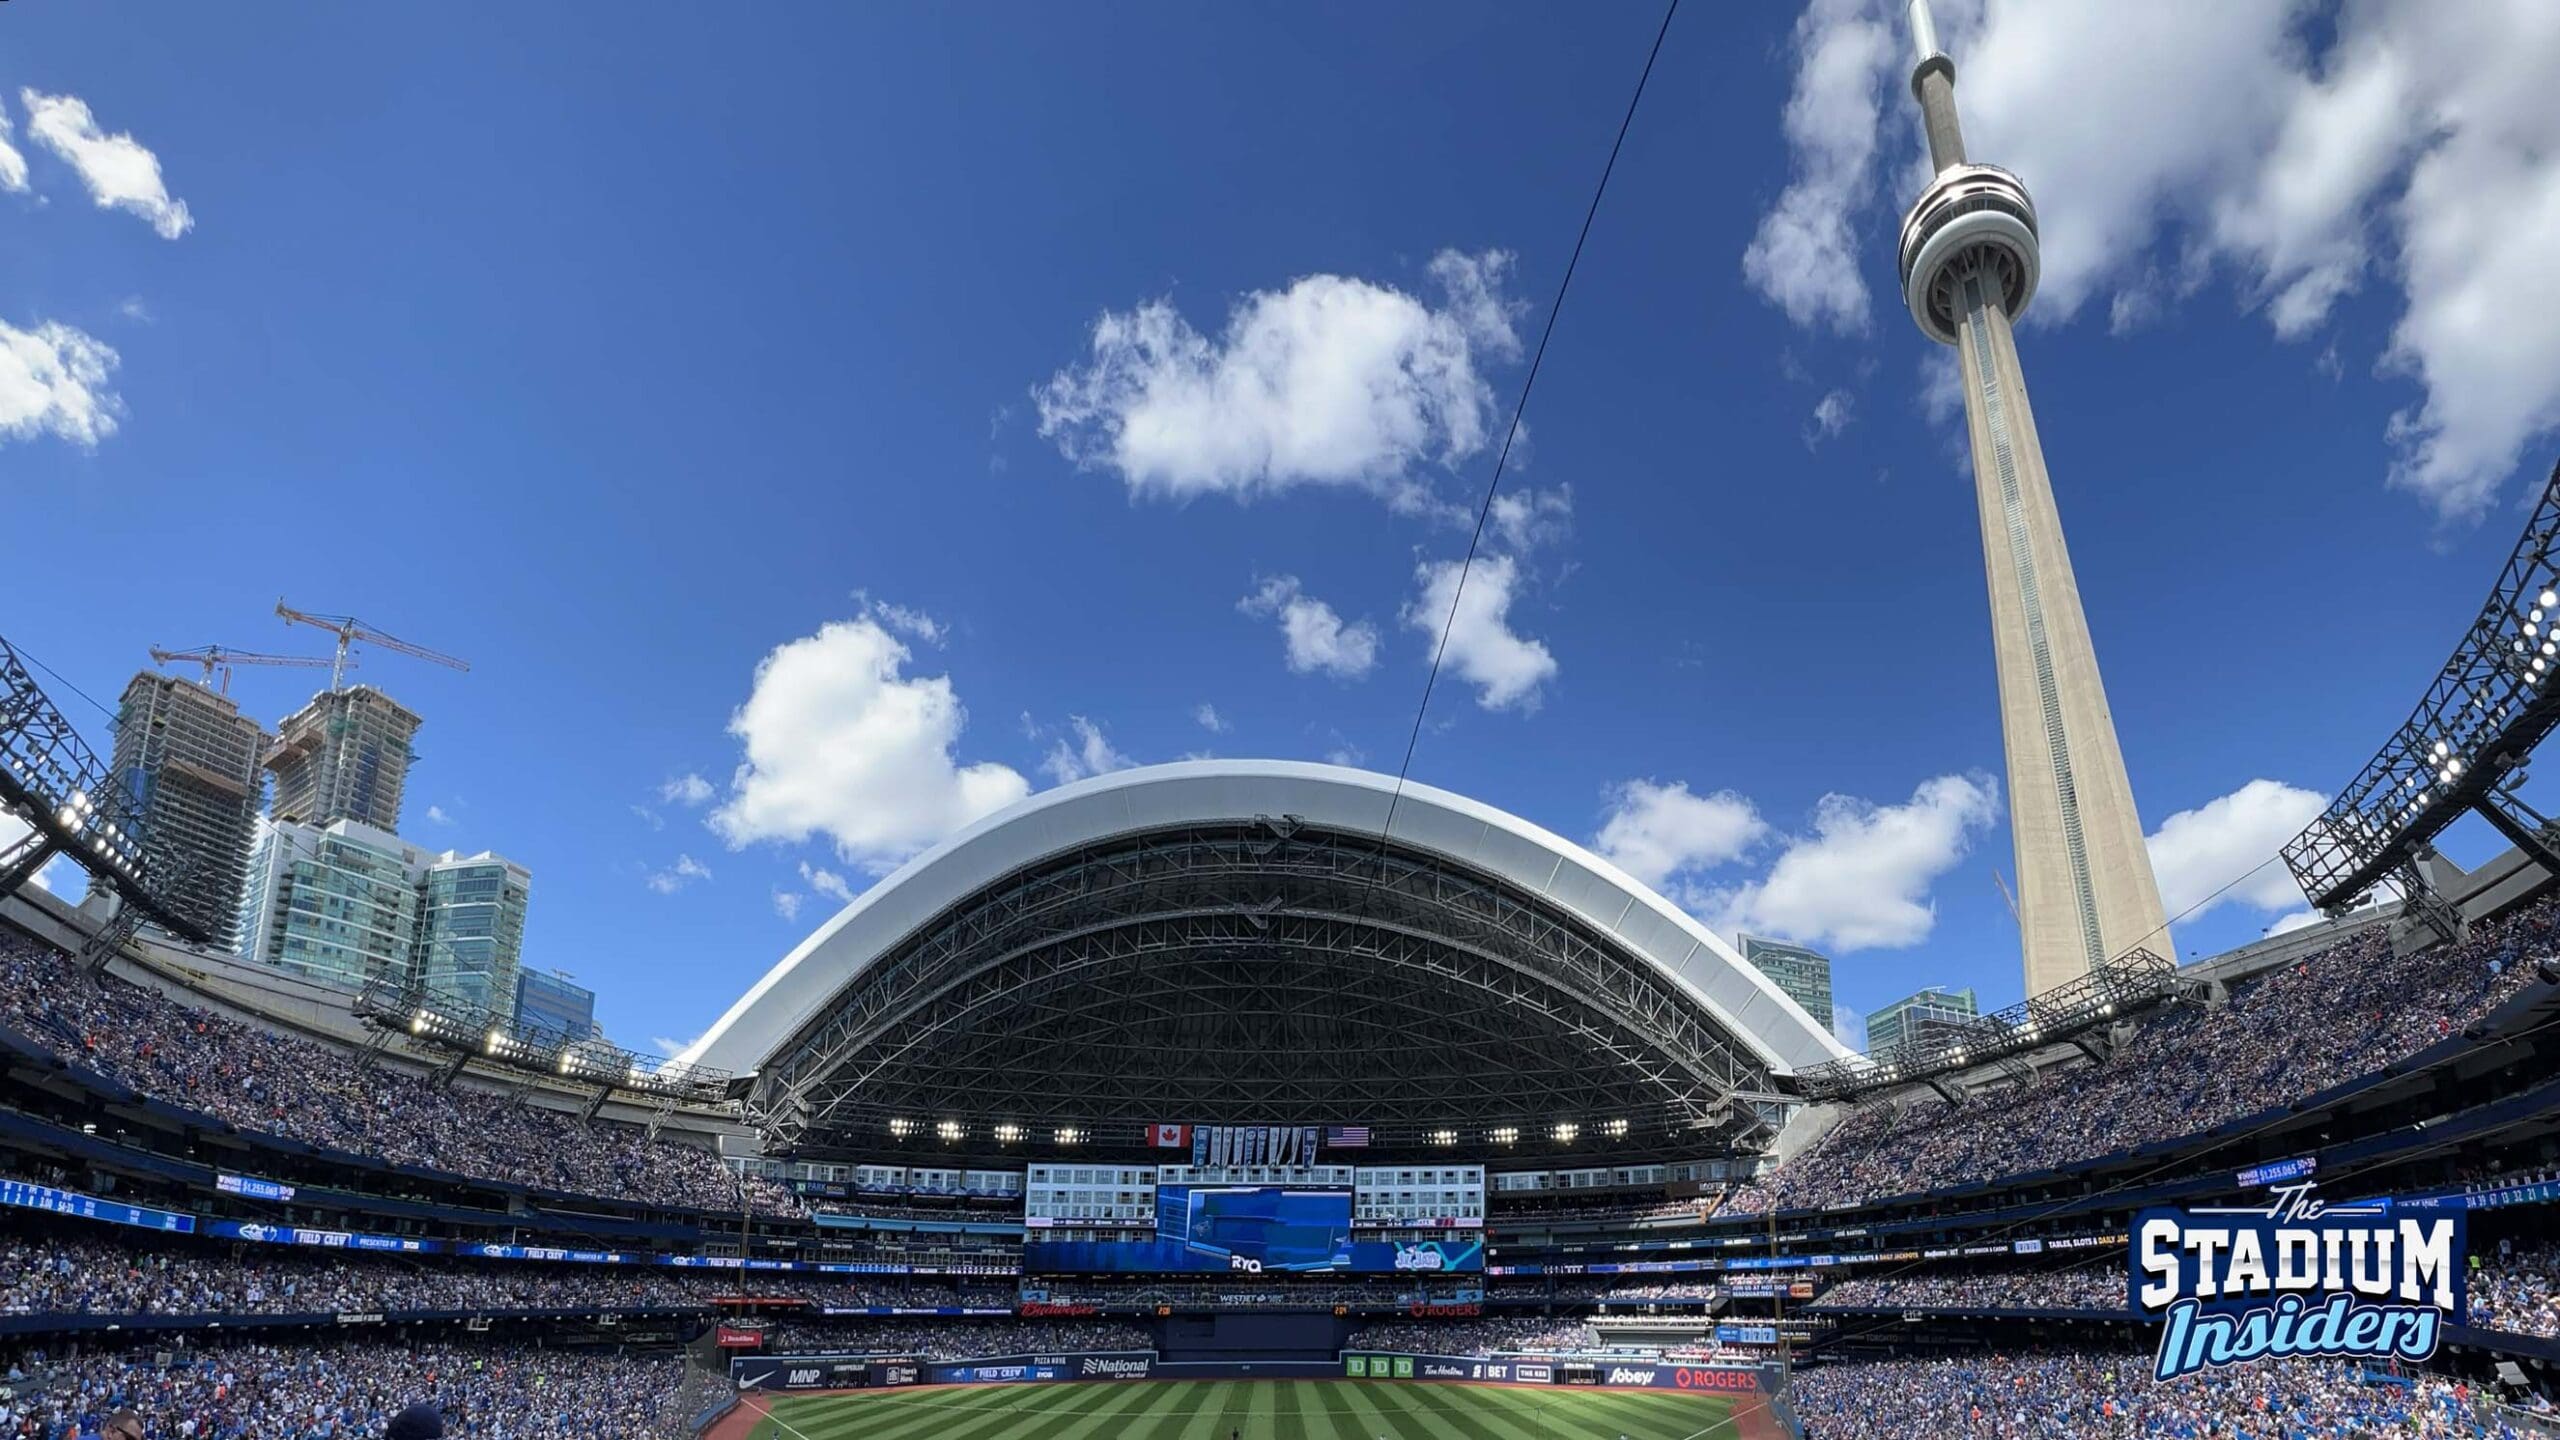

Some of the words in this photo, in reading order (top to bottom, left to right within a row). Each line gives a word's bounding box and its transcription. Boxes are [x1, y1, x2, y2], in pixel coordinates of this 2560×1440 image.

[299, 1232, 321, 1245] FIELD
[1021, 1302, 1096, 1317] Budweiser
[1426, 1304, 1480, 1316] ROGERS
[1034, 1357, 1051, 1365] PIZZA
[1098, 1359, 1149, 1372] National
[1349, 1360, 1365, 1373] TD
[1373, 1361, 1388, 1374] TD
[1396, 1361, 1412, 1374] TD
[789, 1369, 820, 1384] MNP
[979, 1369, 998, 1378] FIELD
[1001, 1368, 1021, 1378] CREW
[1424, 1365, 1438, 1376] Tim
[1438, 1365, 1464, 1376] Hortons
[1488, 1365, 1508, 1378] BET
[1608, 1367, 1655, 1386] Sobeys
[1694, 1370, 1756, 1388] ROGERS
